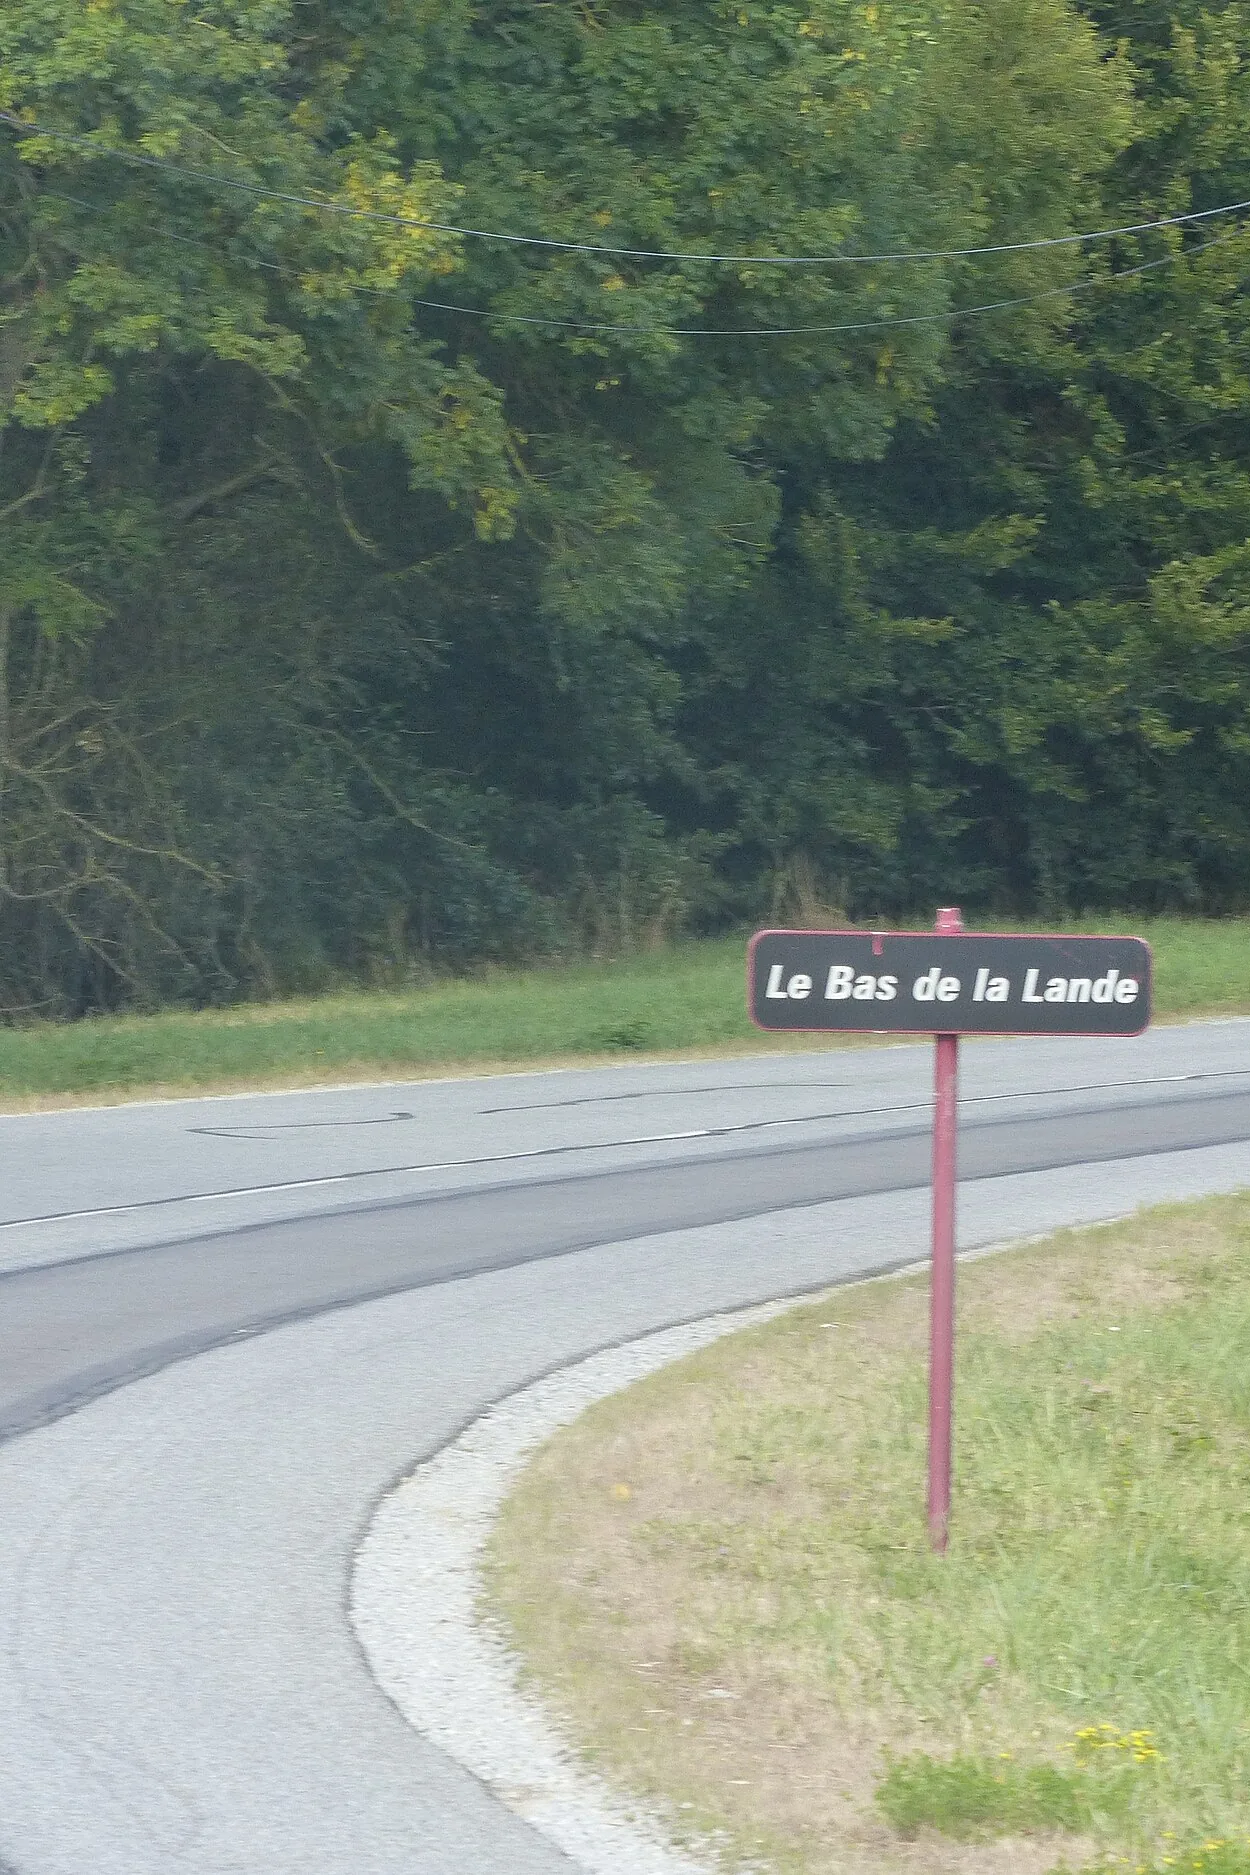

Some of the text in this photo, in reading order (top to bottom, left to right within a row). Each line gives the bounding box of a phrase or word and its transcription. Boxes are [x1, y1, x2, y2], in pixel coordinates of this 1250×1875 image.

[765, 964, 1140, 1004] Le Bas de la Lande
